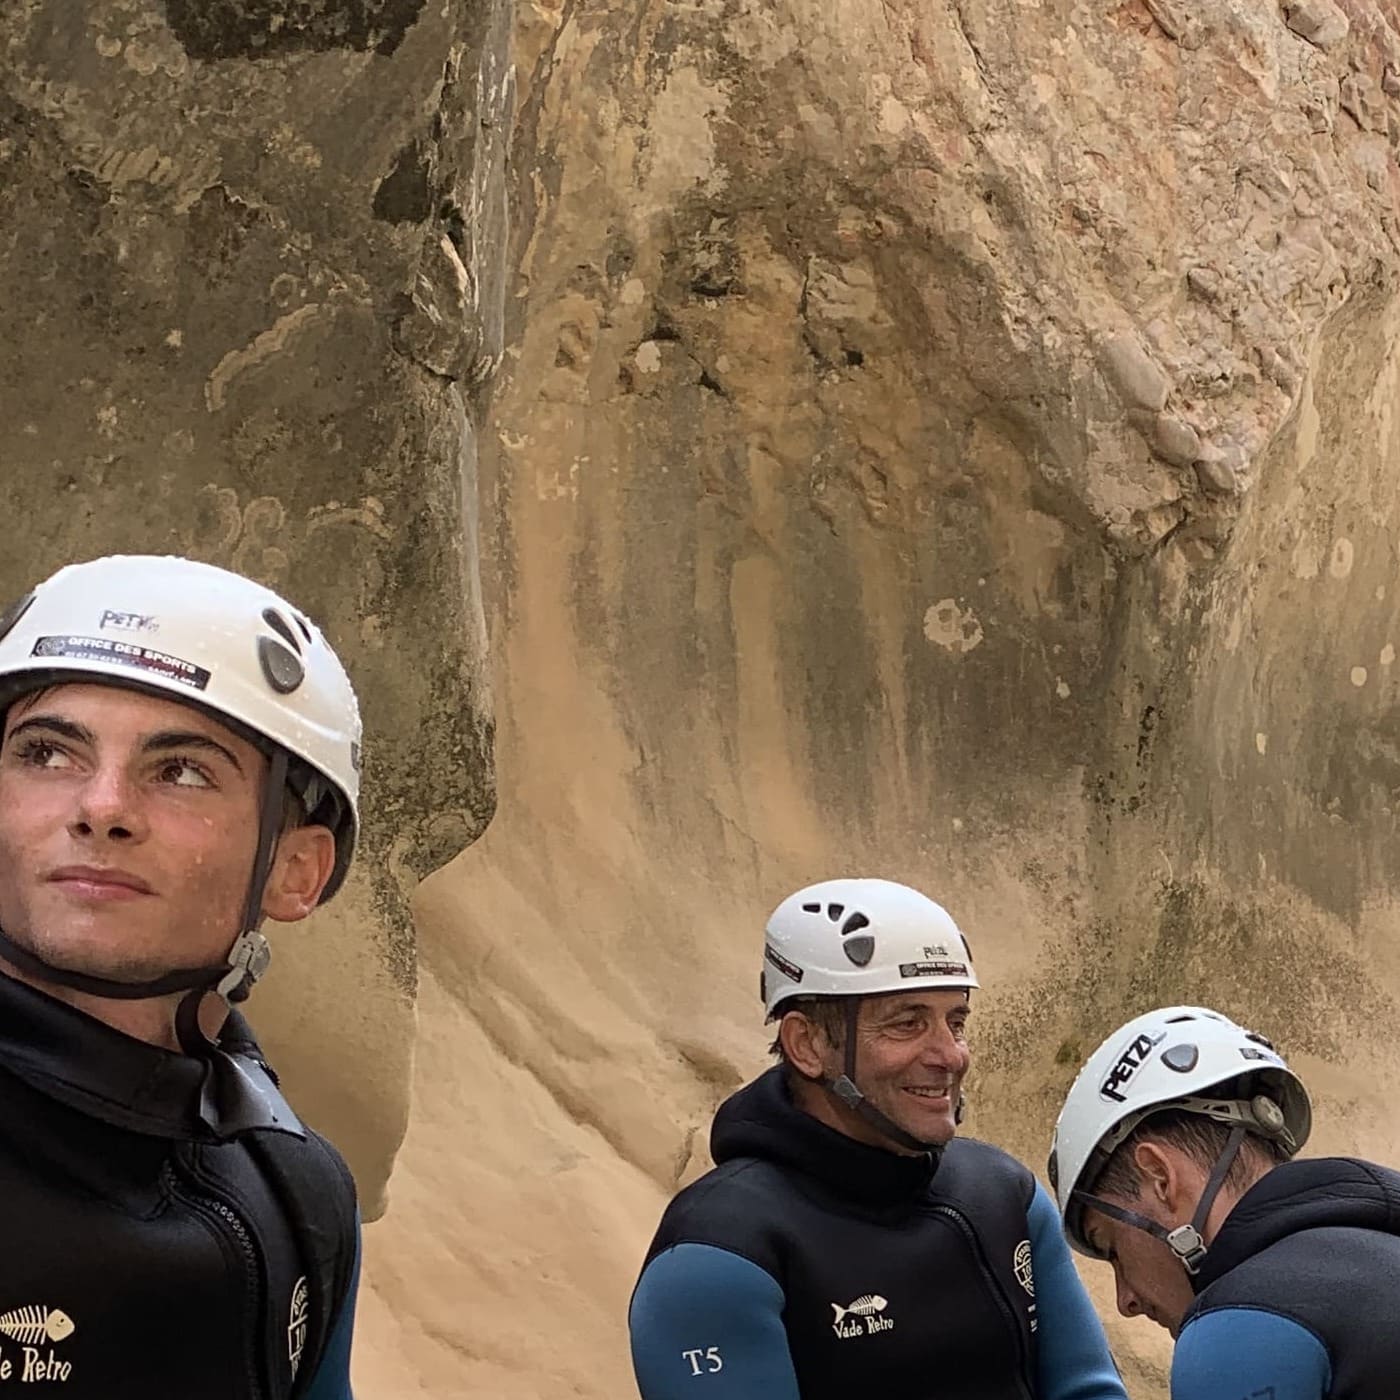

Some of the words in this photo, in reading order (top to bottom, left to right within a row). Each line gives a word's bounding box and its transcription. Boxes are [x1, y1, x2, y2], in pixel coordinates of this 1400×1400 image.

[68, 637, 112, 650] OFFICE
[114, 644, 142, 656] DES
[144, 650, 197, 674] SPORTS
[832, 1320, 864, 1339] Vade
[864, 1315, 894, 1334] Retro
[22, 1347, 72, 1382] Retro
[683, 1347, 723, 1376] T5
